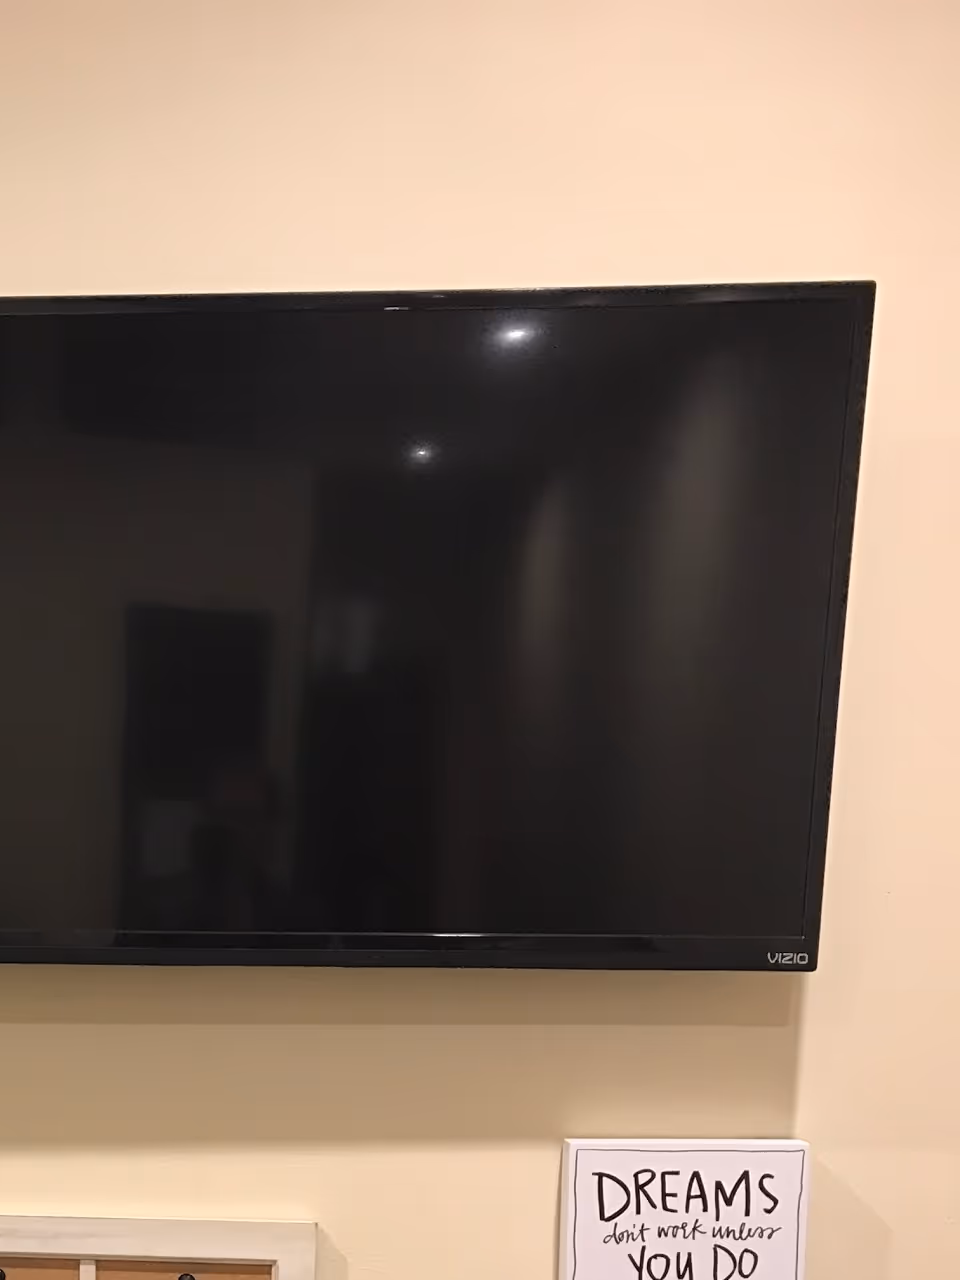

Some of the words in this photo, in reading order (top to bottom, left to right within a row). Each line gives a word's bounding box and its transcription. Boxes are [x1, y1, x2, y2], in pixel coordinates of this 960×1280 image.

[767, 952, 809, 965] VIZIO
[591, 1168, 779, 1222] DREAMS
[602, 1222, 651, 1245] don't
[657, 1218, 707, 1241] work
[711, 1222, 783, 1241] unless
